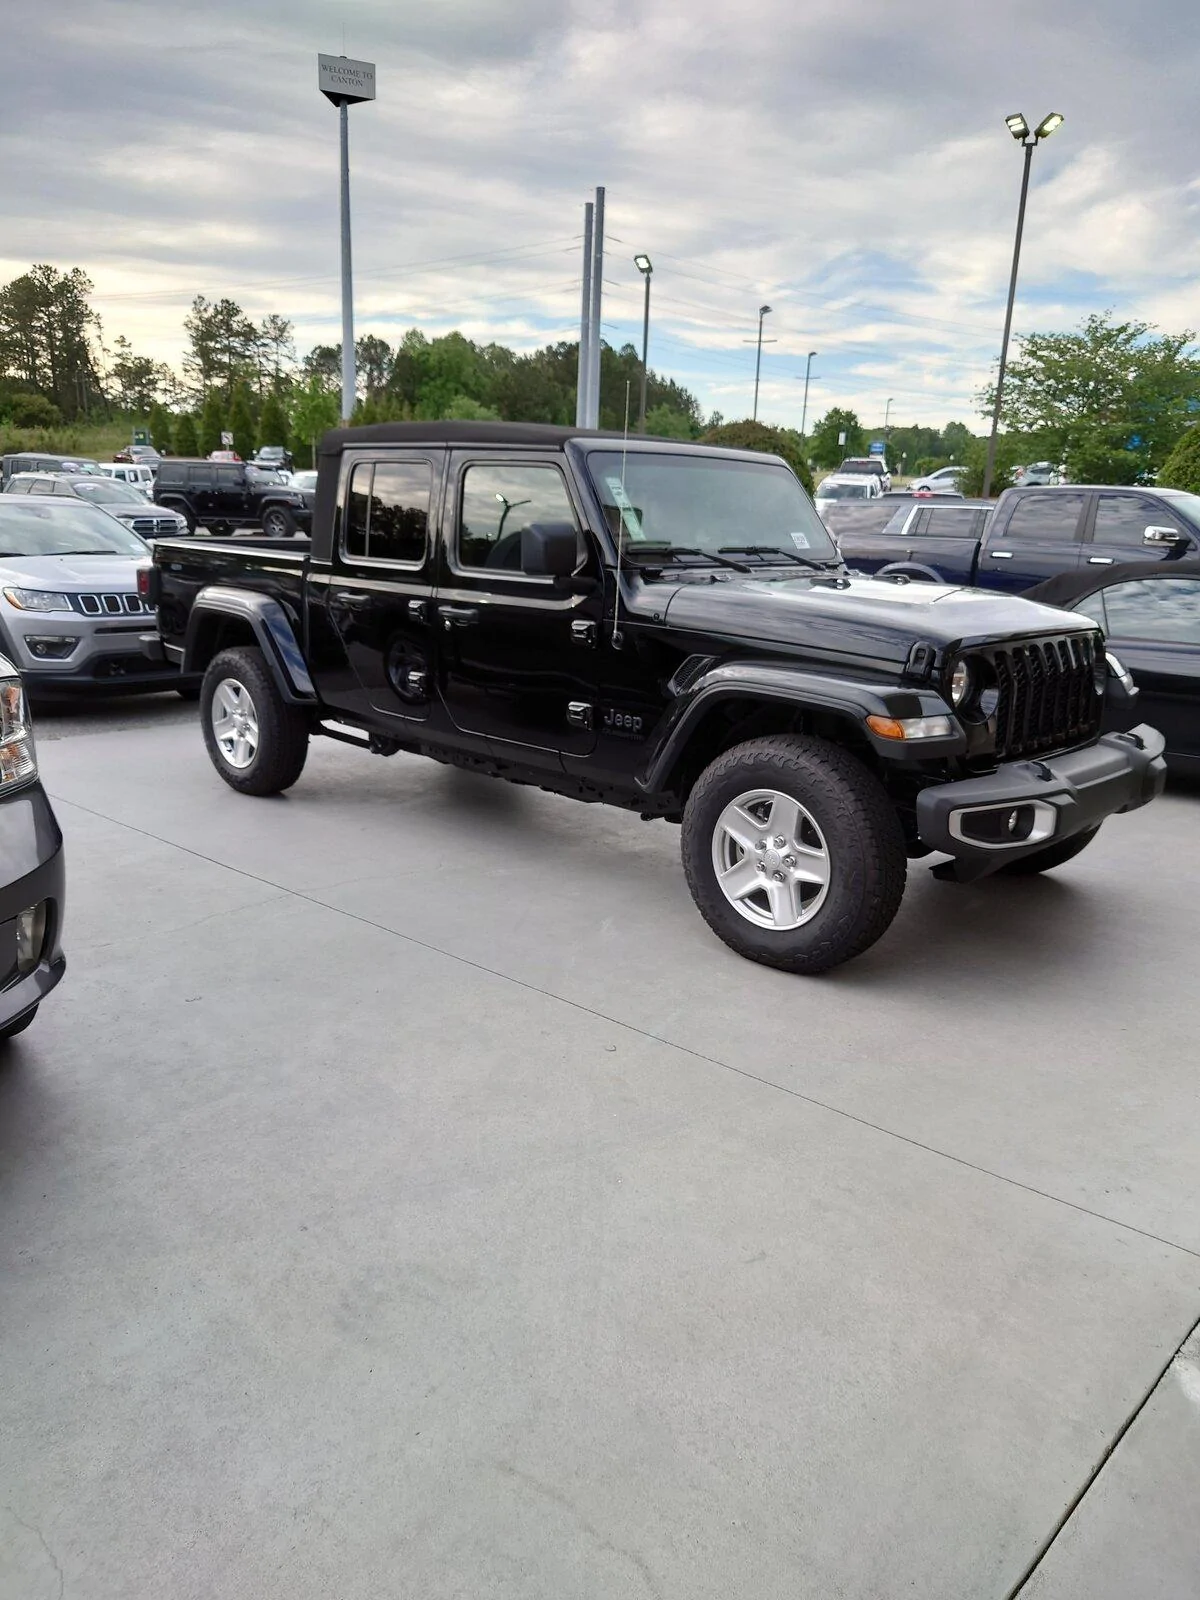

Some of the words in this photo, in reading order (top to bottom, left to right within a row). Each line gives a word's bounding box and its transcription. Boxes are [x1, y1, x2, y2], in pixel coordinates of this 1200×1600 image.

[321, 64, 361, 78] WELCOME
[362, 71, 373, 80] TO
[331, 75, 363, 87] CANTON
[604, 708, 643, 732] Jeep
